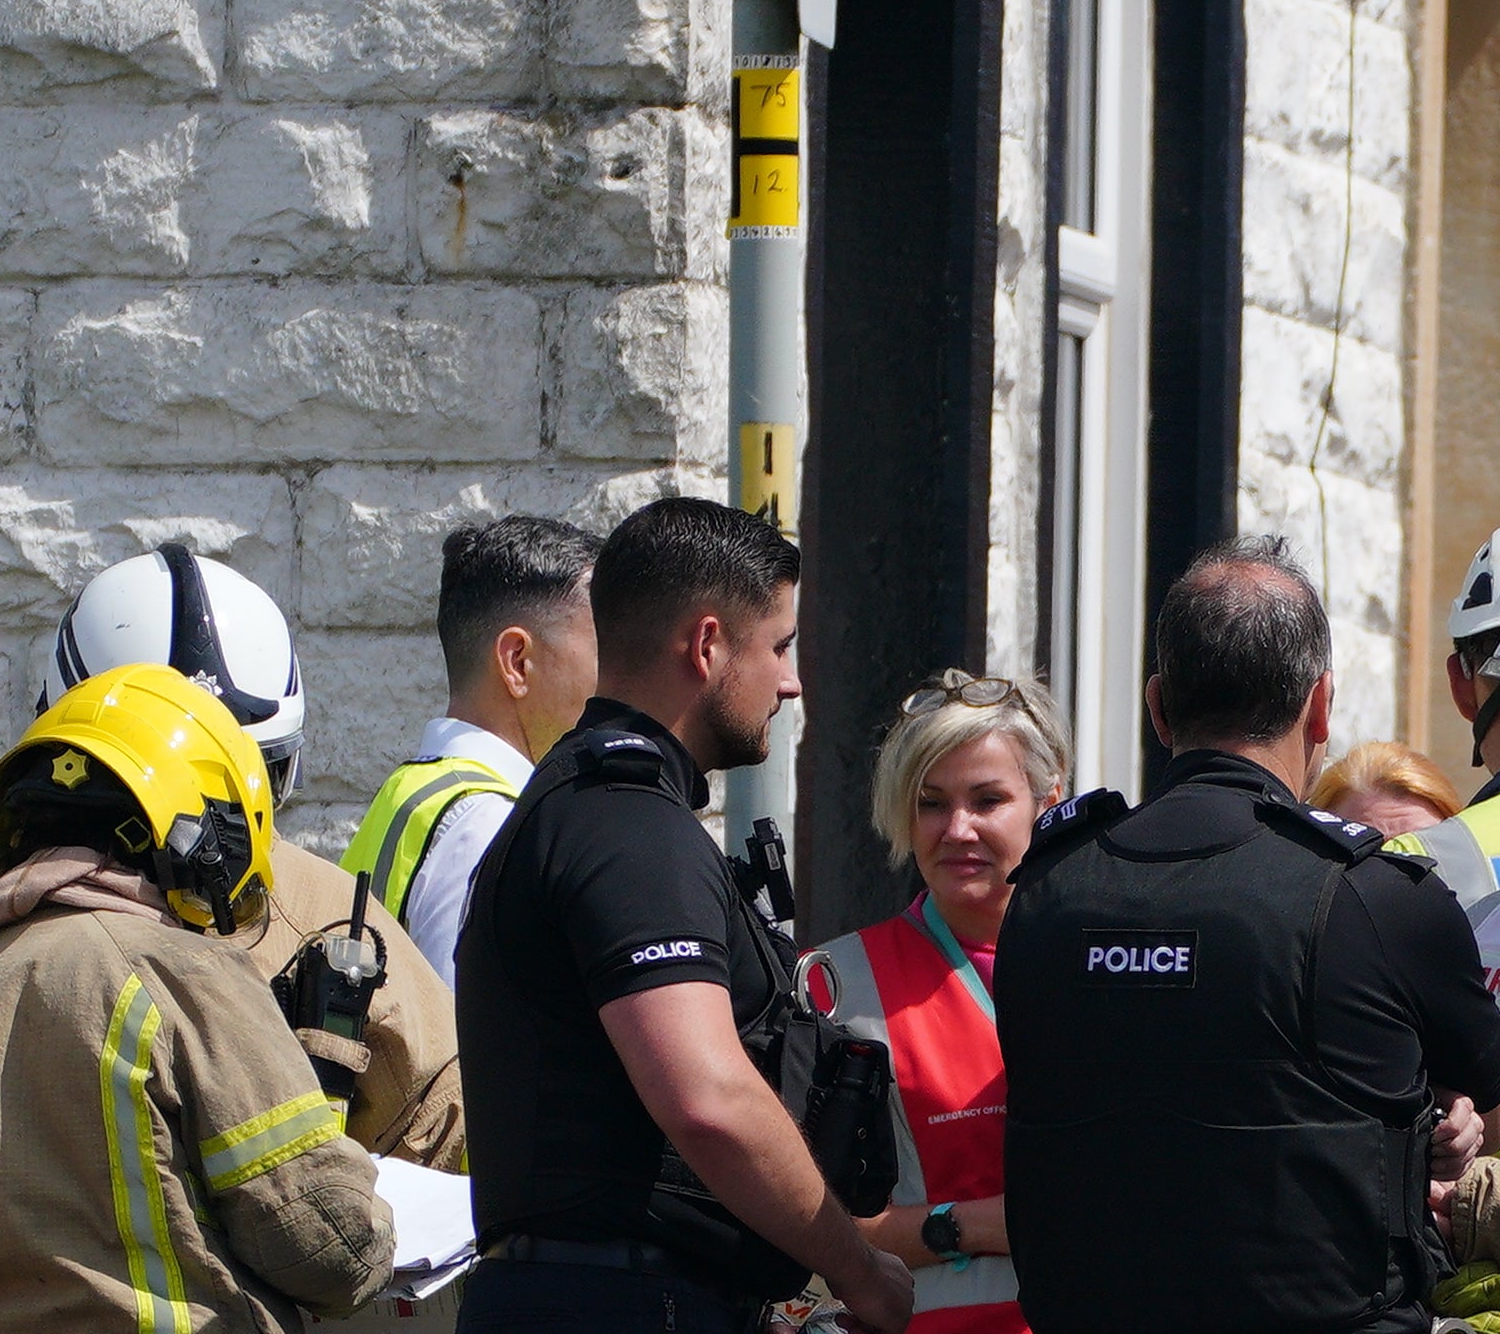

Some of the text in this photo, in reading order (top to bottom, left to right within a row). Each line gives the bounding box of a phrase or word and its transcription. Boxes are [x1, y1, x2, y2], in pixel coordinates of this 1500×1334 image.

[750, 82, 791, 108] 75
[753, 168, 784, 195] 12
[631, 941, 702, 964] POLICE
[1088, 946, 1190, 973] POLICE
